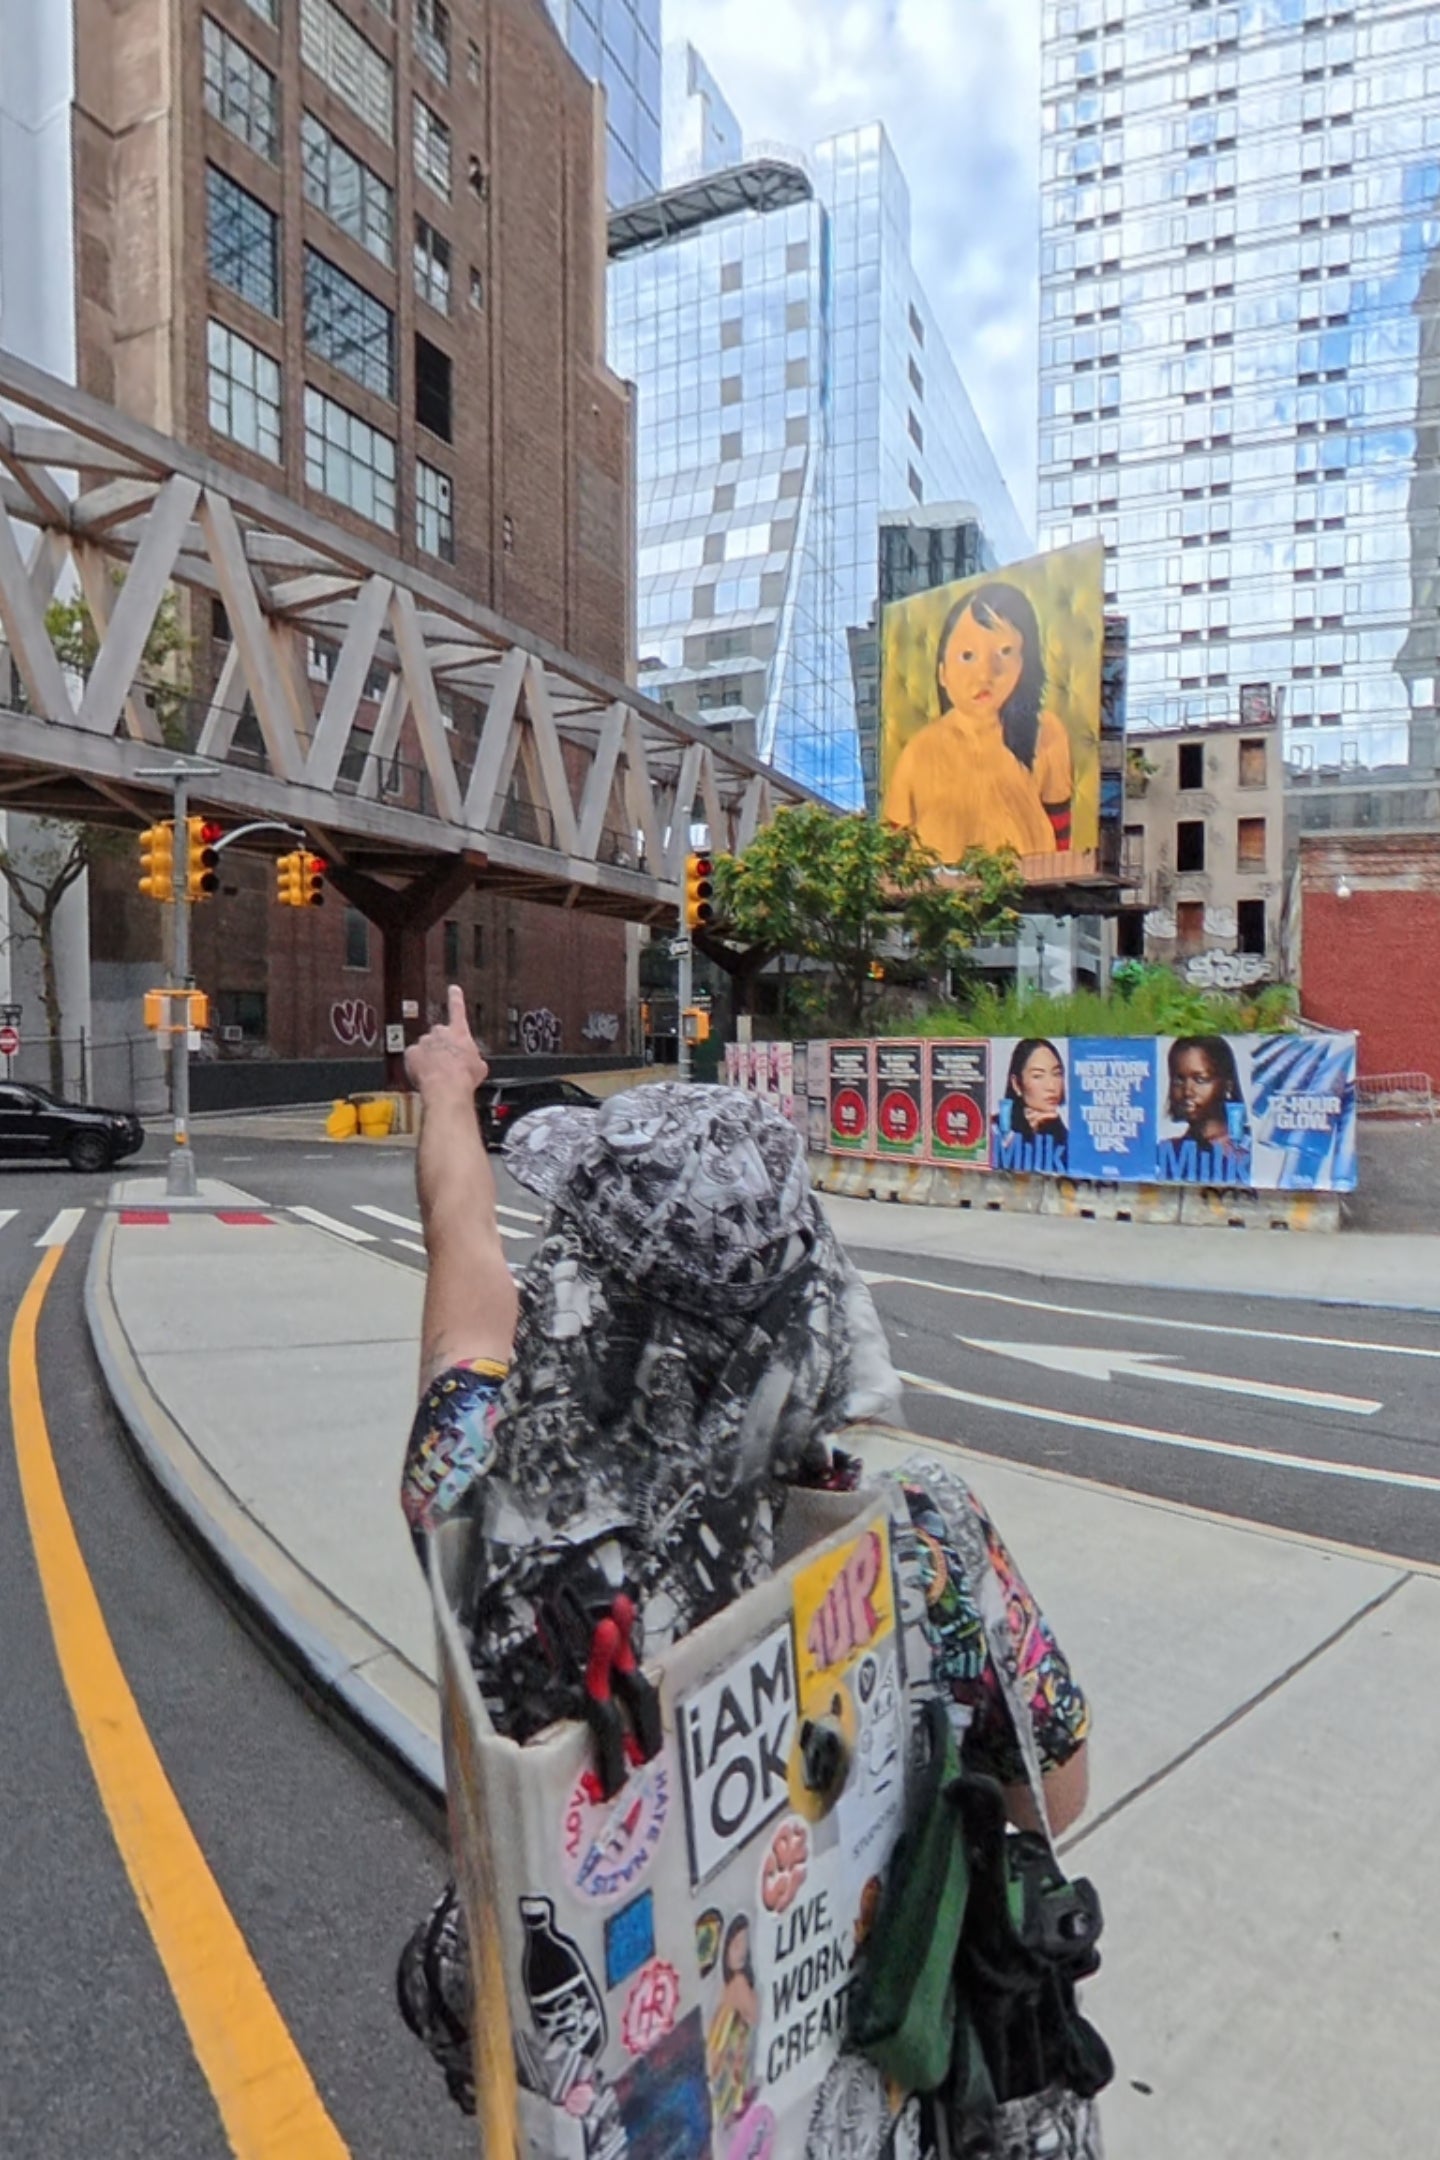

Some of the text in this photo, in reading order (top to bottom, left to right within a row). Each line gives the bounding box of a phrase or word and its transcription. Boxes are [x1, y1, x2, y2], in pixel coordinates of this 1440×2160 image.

[1111, 1062, 1150, 1077] YORK
[1081, 1076, 1143, 1092] DOESN'T
[1115, 1107, 1145, 1123] FOR
[1087, 1121, 1138, 1138] TOUCH
[711, 1712, 790, 1838] OK
[766, 1974, 860, 2085] CREAT
